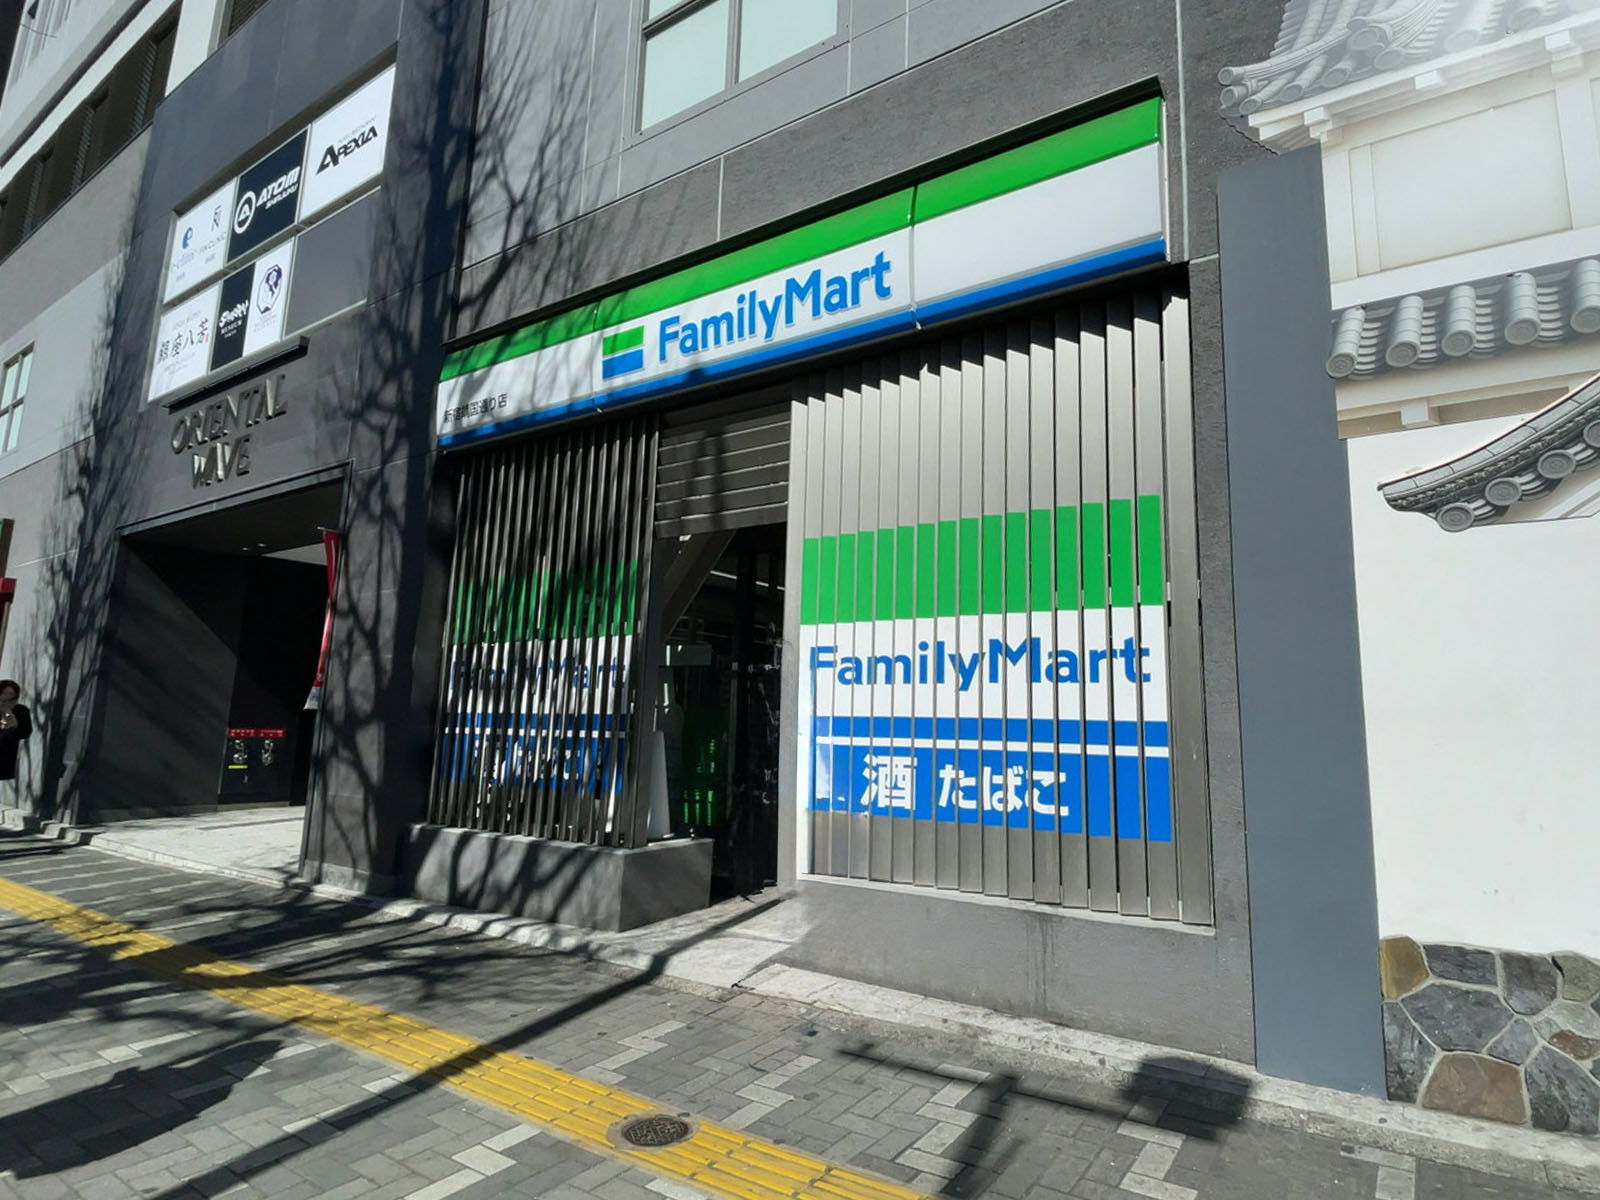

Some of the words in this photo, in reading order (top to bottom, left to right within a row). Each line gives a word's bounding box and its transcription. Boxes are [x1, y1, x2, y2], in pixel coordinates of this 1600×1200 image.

[315, 125, 378, 175] APEXIA
[256, 166, 300, 207] ATOM
[658, 251, 892, 362] FamilyMart
[171, 373, 286, 455] ORIENTAL
[192, 432, 250, 489] WAVE
[810, 636, 1151, 692] FamilyMart
[860, 753, 918, 810] 酒
[938, 763, 1070, 816] たばこ
